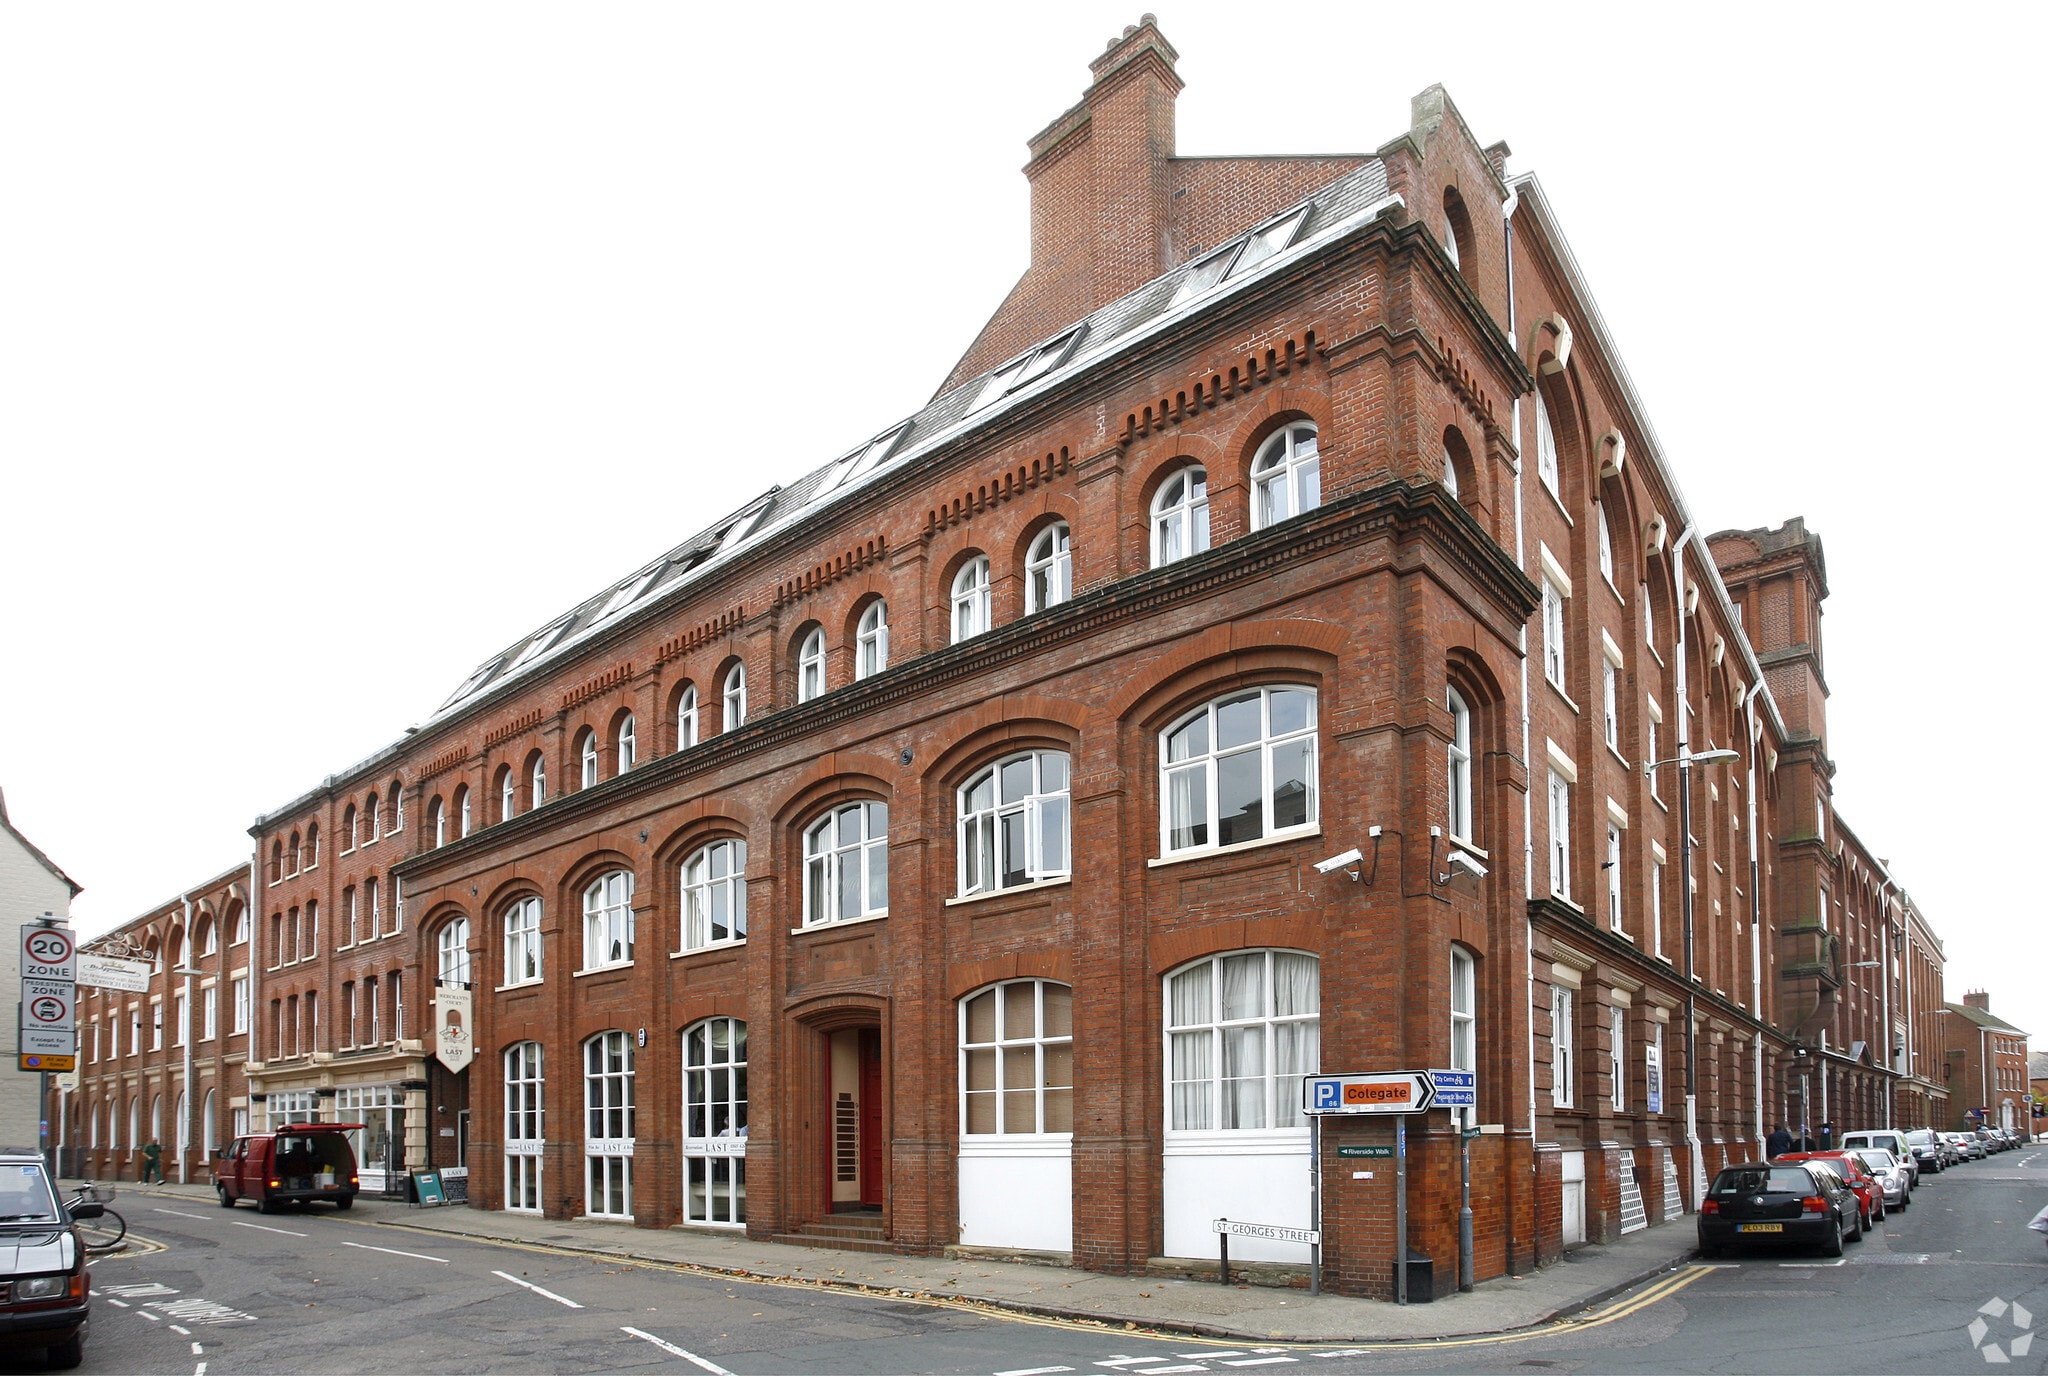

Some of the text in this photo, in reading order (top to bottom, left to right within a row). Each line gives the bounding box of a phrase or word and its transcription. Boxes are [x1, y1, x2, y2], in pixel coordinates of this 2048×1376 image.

[33, 939, 65, 955] 20
[28, 965, 70, 976] ZONE
[32, 987, 66, 996] ZONE
[1317, 1084, 1334, 1107] P
[1347, 1087, 1407, 1100] Colegate
[603, 1143, 620, 1152] LAST
[705, 1143, 728, 1152] LAST
[1232, 1224, 1275, 1237] GEORGES
[1279, 1229, 1315, 1242] STREET
[1742, 1224, 1781, 1232] PL03 RBY
